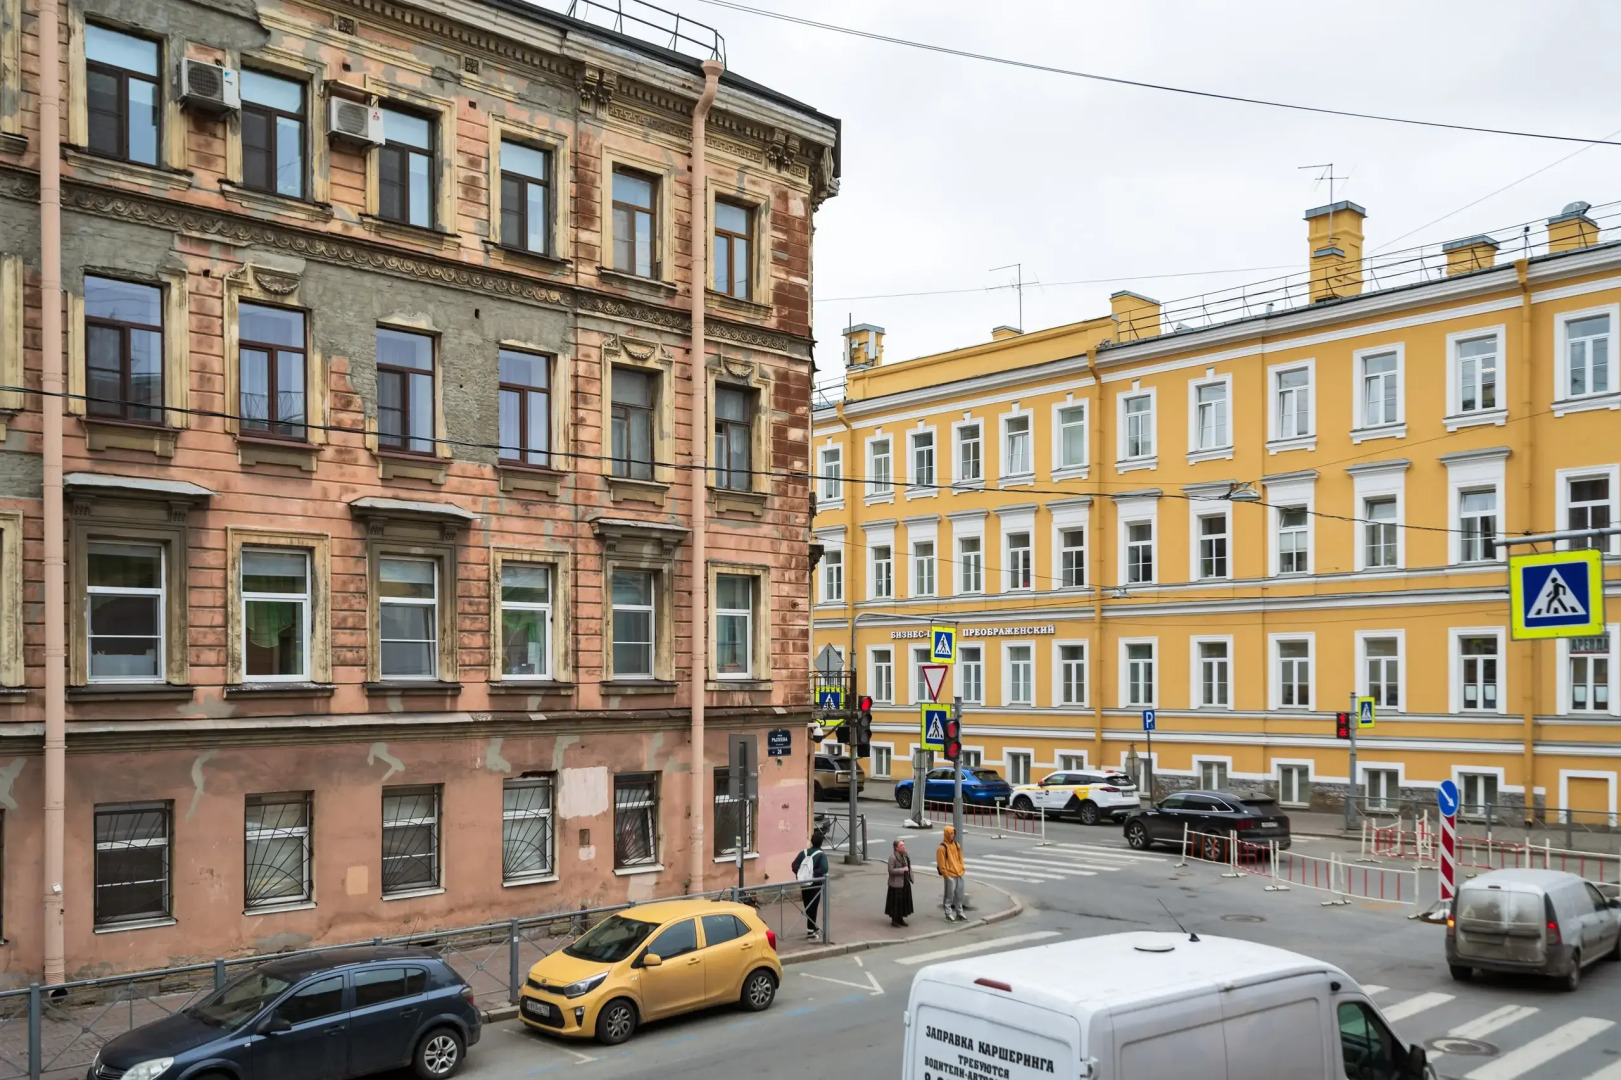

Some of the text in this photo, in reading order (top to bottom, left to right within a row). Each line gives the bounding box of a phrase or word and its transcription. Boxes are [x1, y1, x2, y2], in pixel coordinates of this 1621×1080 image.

[962, 624, 1055, 637] ПРЕОБРАЖЕНСКИЙ
[1146, 712, 1153, 728] P
[925, 1025, 1055, 1073] ЗАПРАВКА КАРШЕРИНГА
[957, 1054, 1010, 1080] ТРЕБУЮТСЯ
